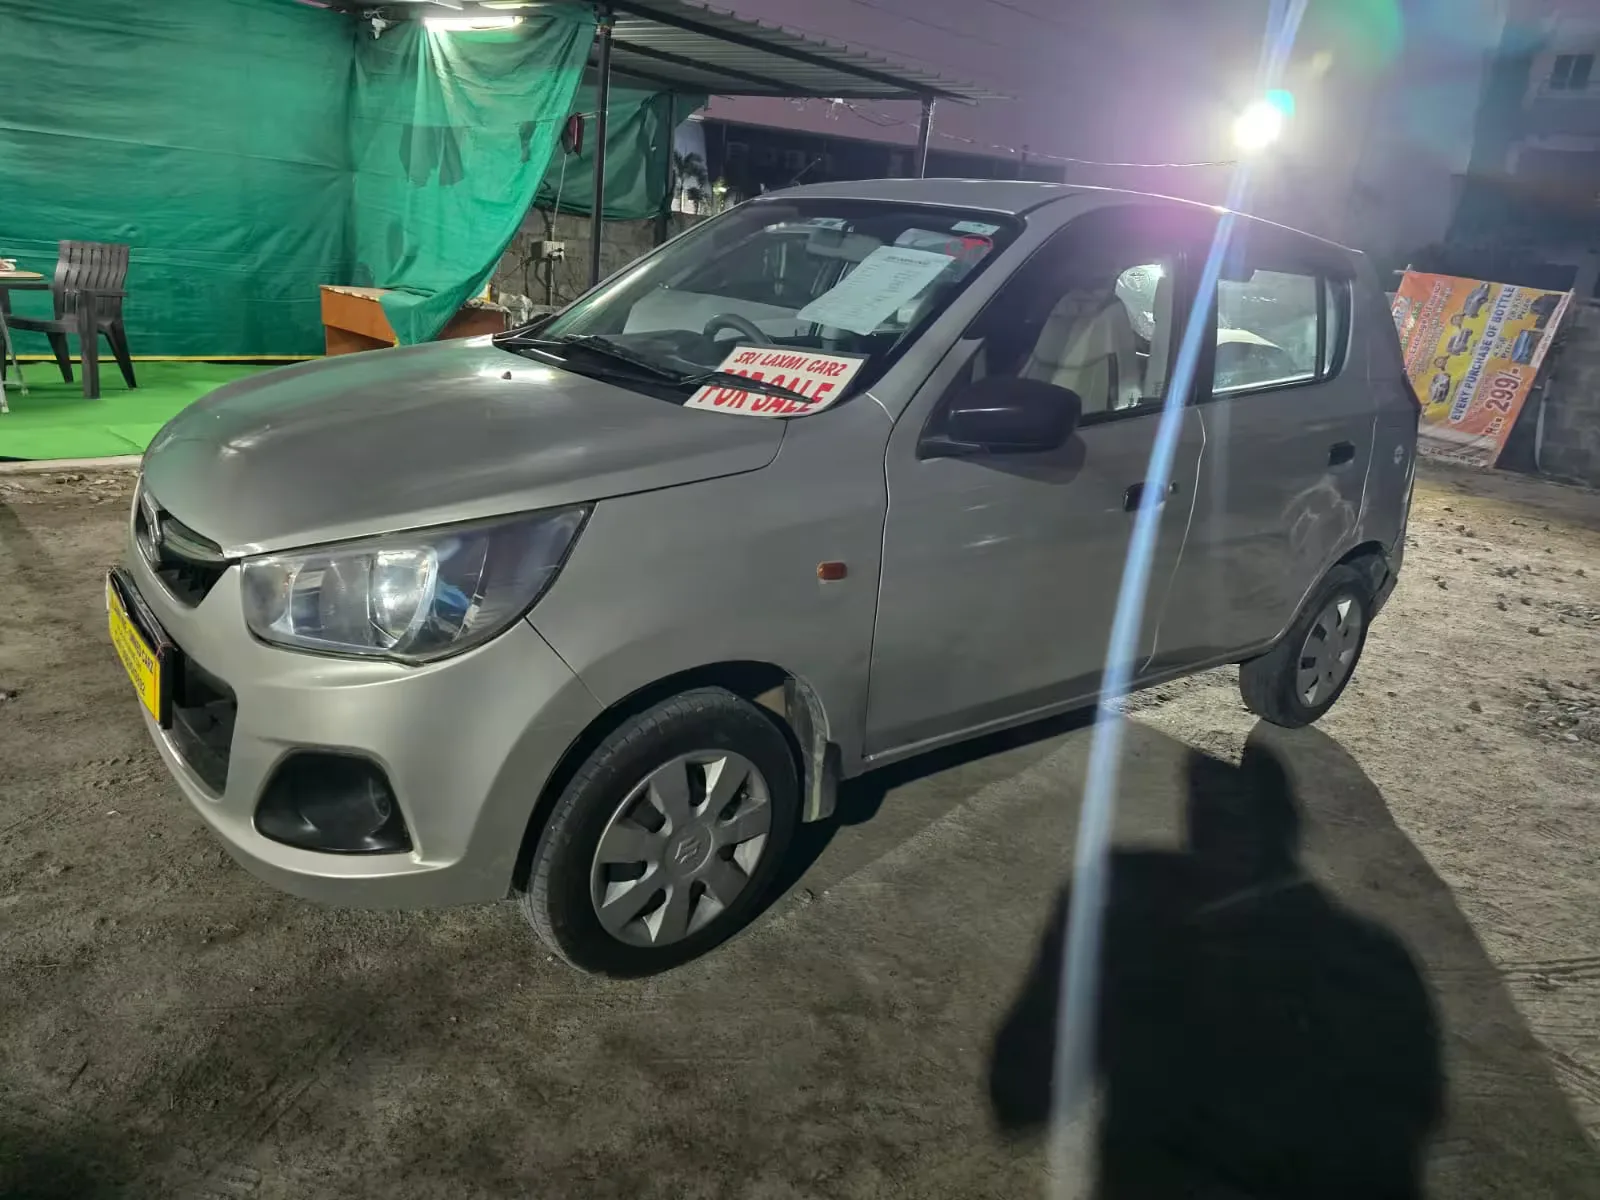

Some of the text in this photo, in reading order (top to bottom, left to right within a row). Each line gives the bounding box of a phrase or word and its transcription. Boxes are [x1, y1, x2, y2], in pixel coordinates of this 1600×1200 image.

[1492, 286, 1516, 322] BOTTLE
[1487, 322, 1498, 338] OF
[734, 352, 759, 365] SRI
[760, 354, 808, 370] LAXMI
[1464, 340, 1493, 388] PURCHASE
[1451, 388, 1471, 421] EVERY
